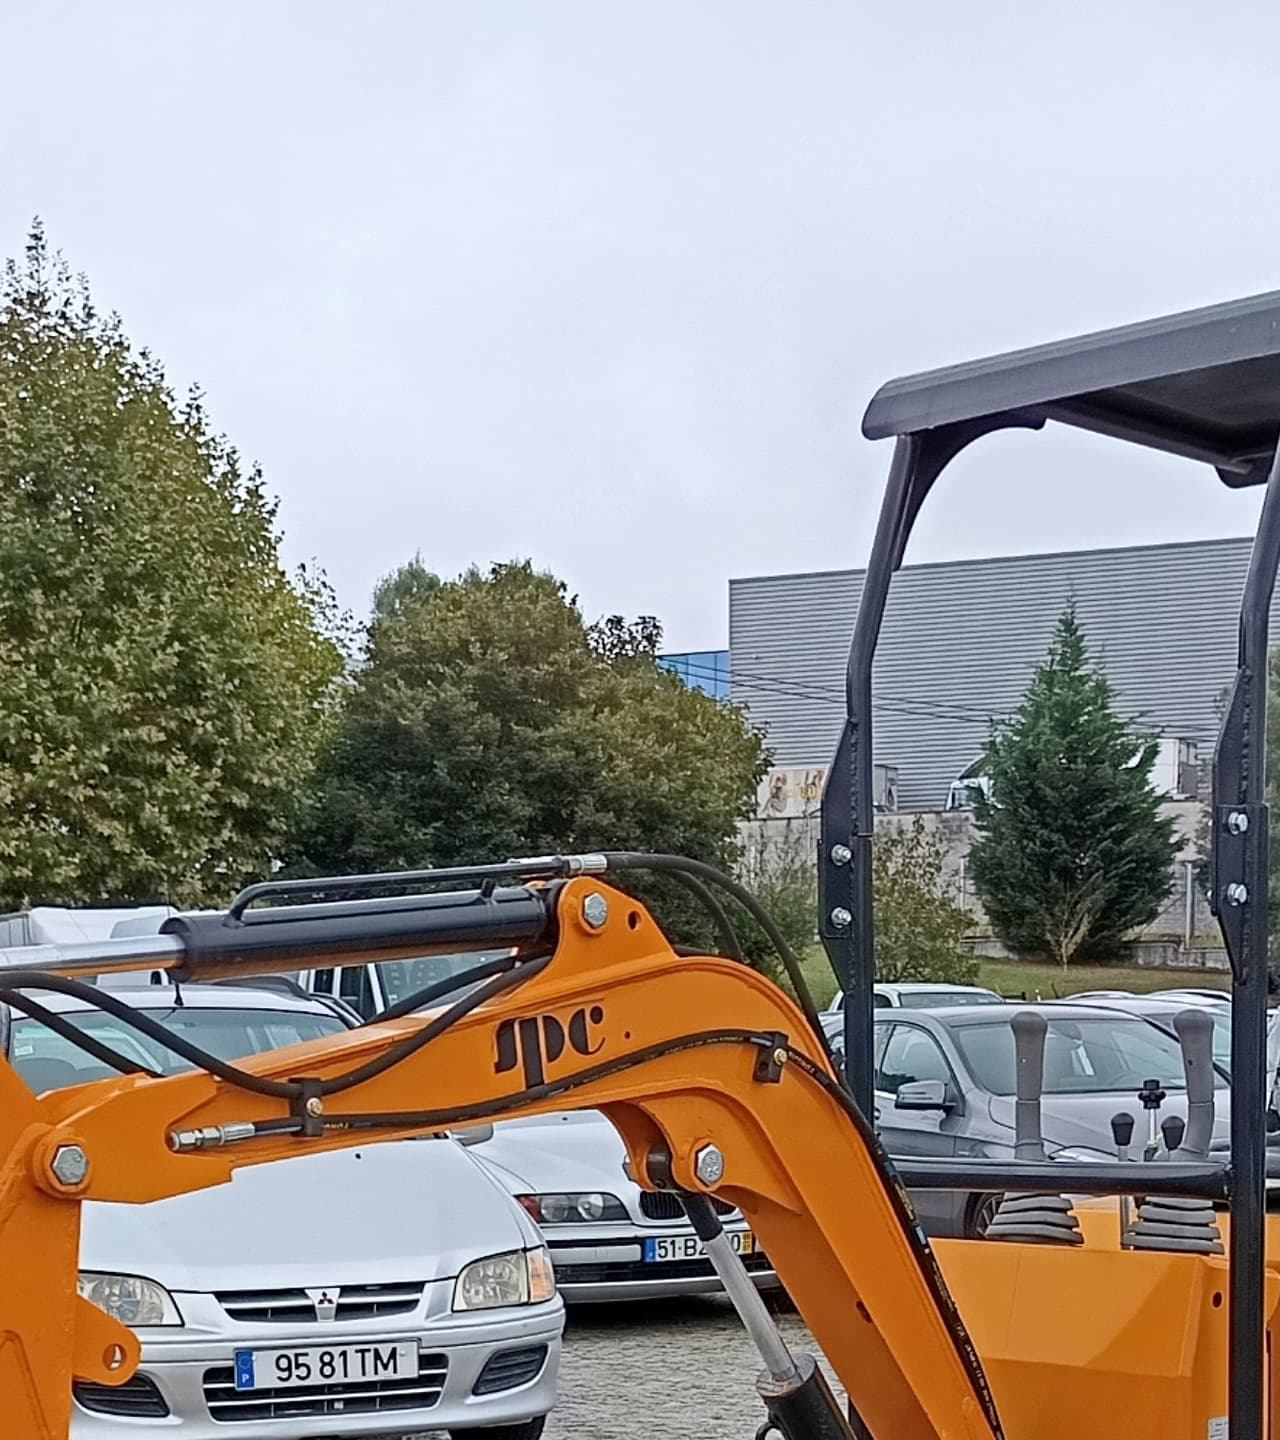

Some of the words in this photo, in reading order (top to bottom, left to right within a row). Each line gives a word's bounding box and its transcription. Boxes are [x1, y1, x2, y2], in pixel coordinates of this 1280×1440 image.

[275, 1352, 312, 1382] 95
[319, 1349, 348, 1379] 81
[354, 1346, 398, 1376] TM
